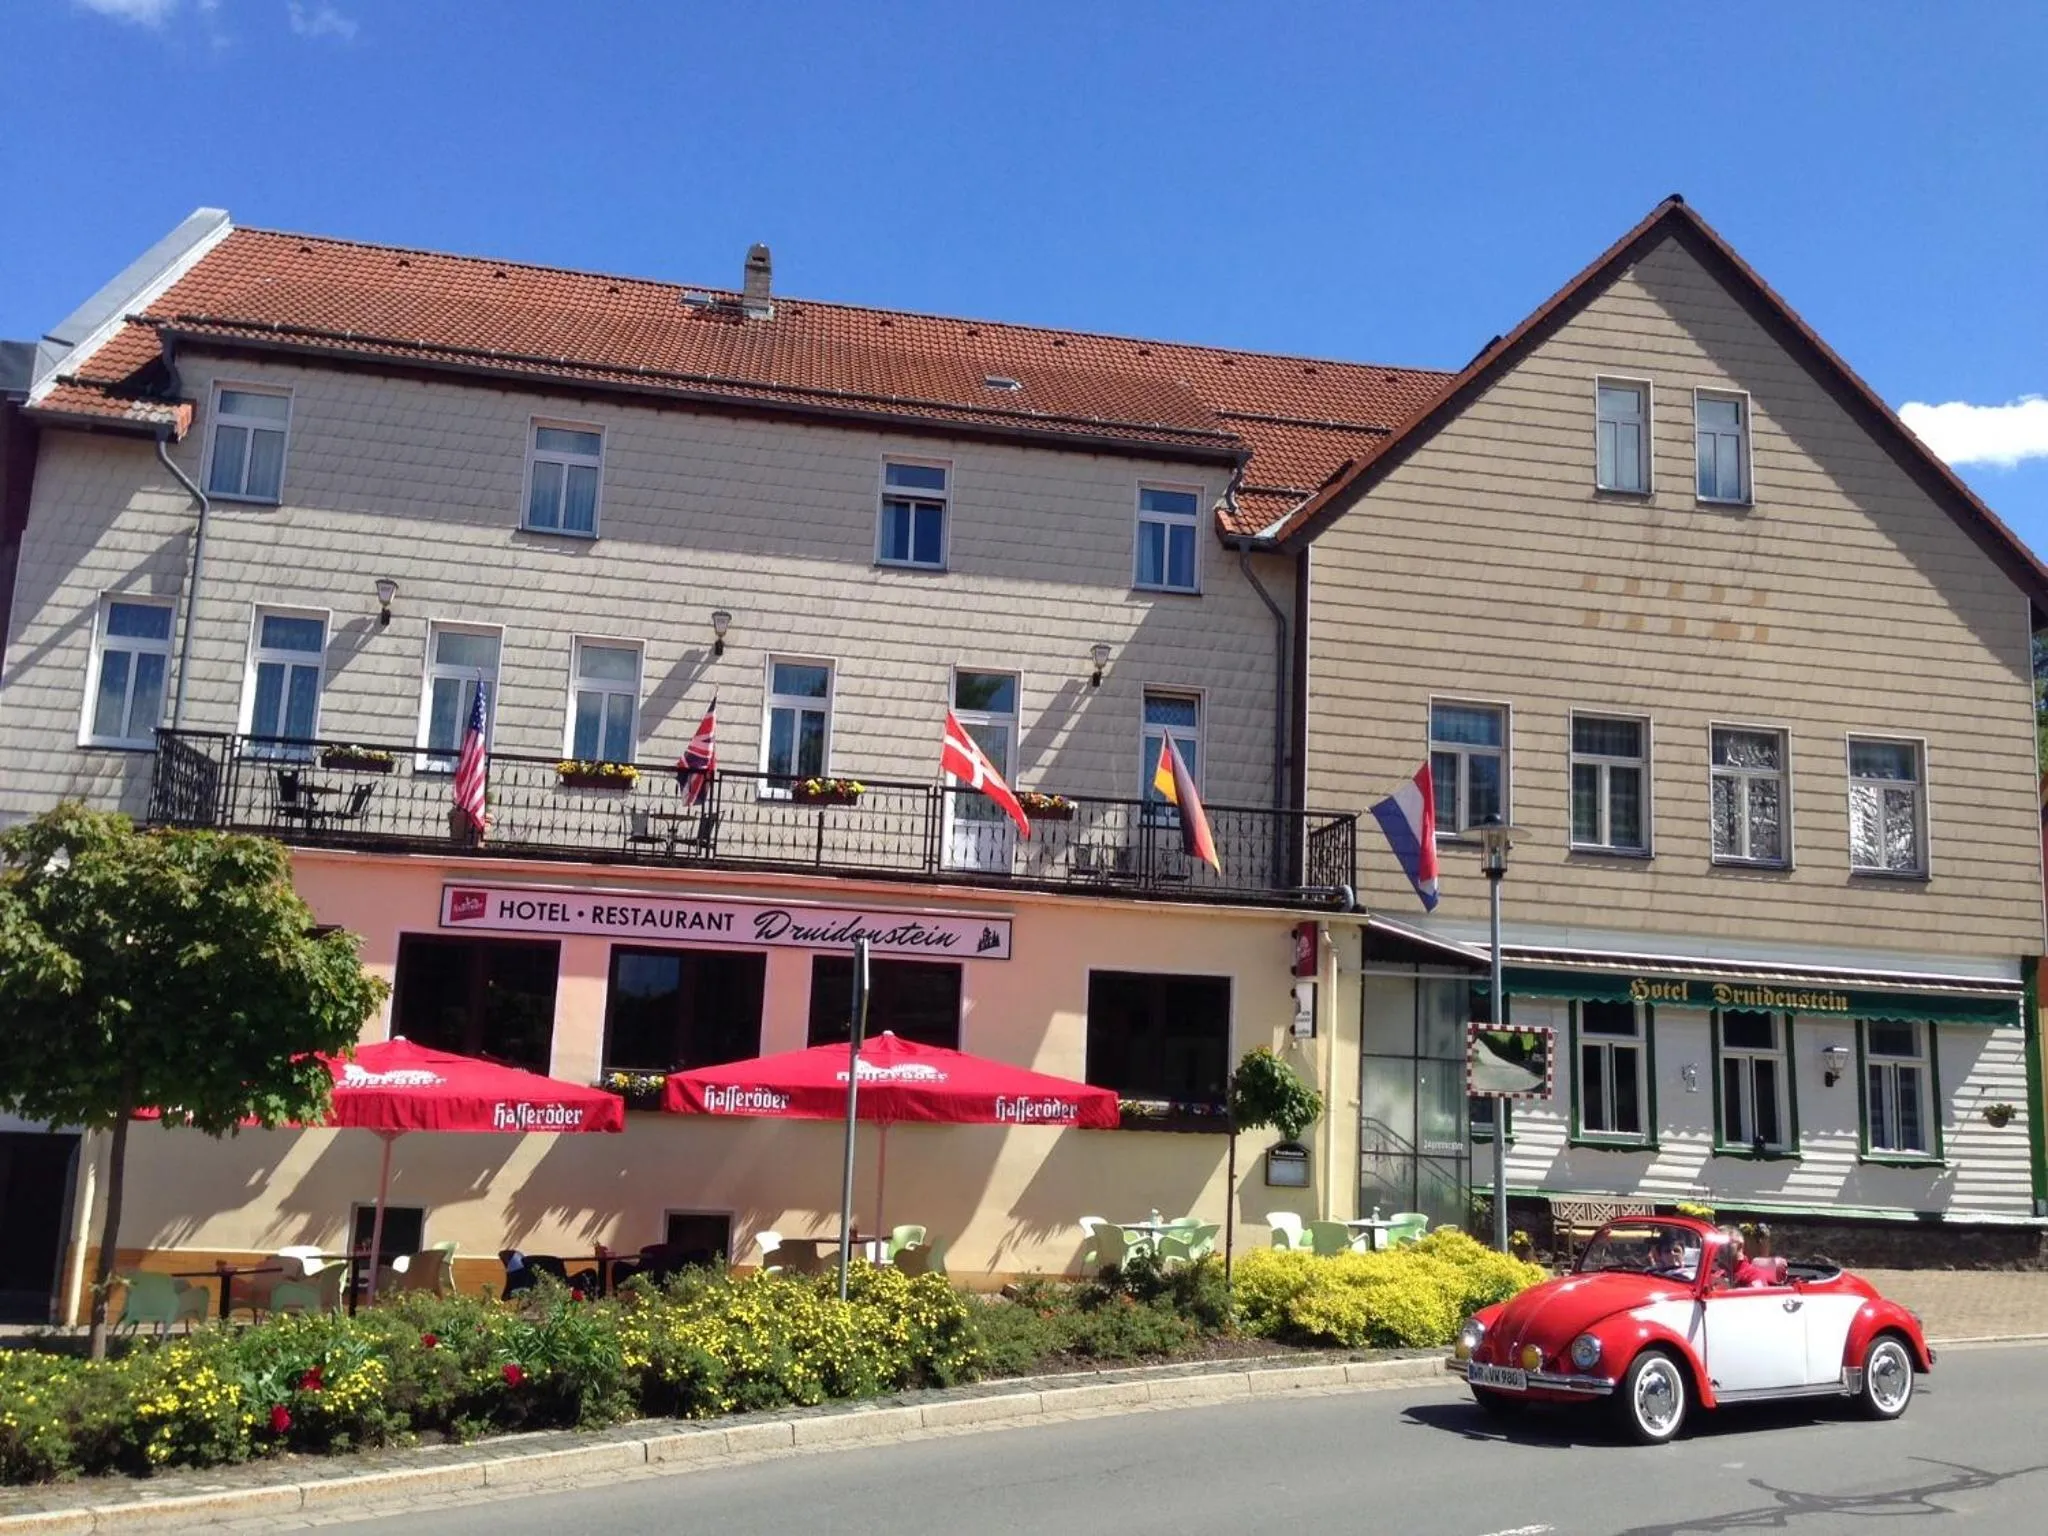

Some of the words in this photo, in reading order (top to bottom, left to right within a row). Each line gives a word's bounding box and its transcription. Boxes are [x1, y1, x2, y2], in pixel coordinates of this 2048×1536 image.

[499, 900, 570, 922] HOTEL
[592, 905, 735, 932] RESTAURANT
[753, 910, 961, 948] Druidenstein
[1629, 978, 1688, 1000] Hotel
[1712, 983, 1849, 1011] Druidenstein
